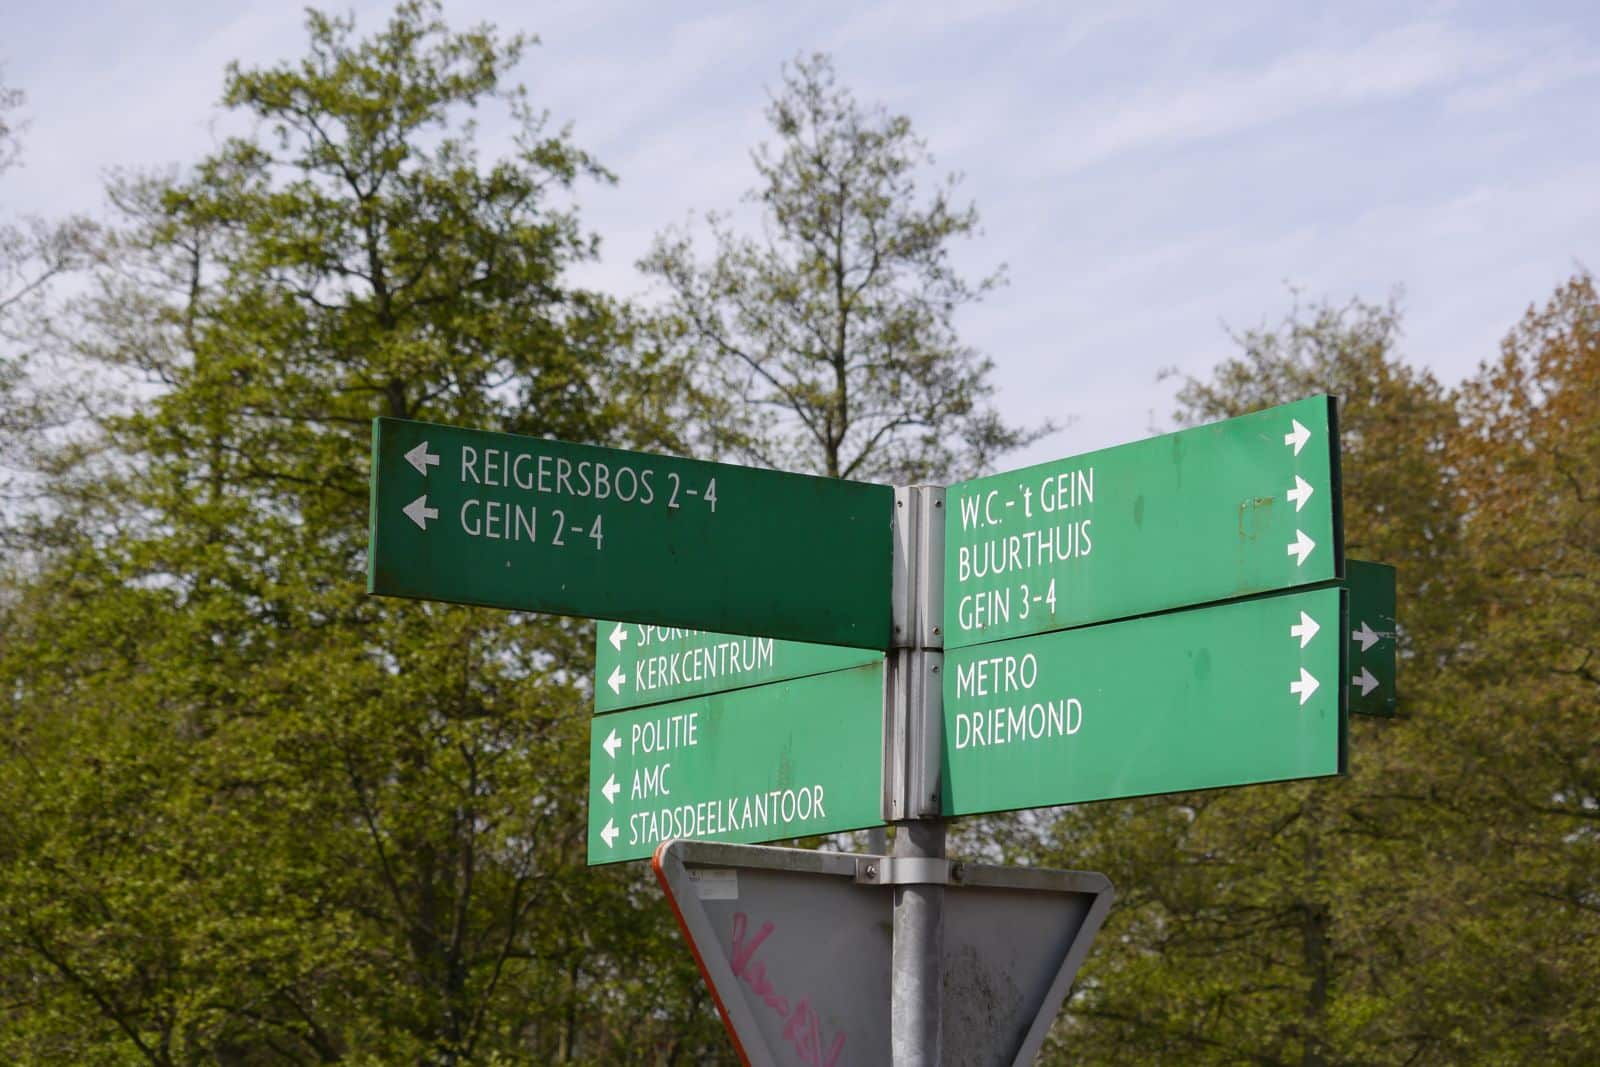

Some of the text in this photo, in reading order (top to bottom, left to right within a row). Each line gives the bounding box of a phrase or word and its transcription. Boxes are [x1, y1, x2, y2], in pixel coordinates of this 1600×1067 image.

[460, 445, 655, 504] REIGERSBOS
[1040, 467, 1094, 513] GEIN
[460, 499, 537, 543] GEIN
[959, 519, 1092, 582] BUURTHUIS
[959, 587, 1010, 630] GEIN
[635, 638, 774, 692] KERKCENTRUM
[956, 653, 1037, 699] METRO
[631, 712, 698, 755] POLITIE
[955, 698, 1083, 749] DRIEMOND
[630, 763, 671, 800] AMC
[629, 784, 826, 846] STADSDEELKANTOOR
